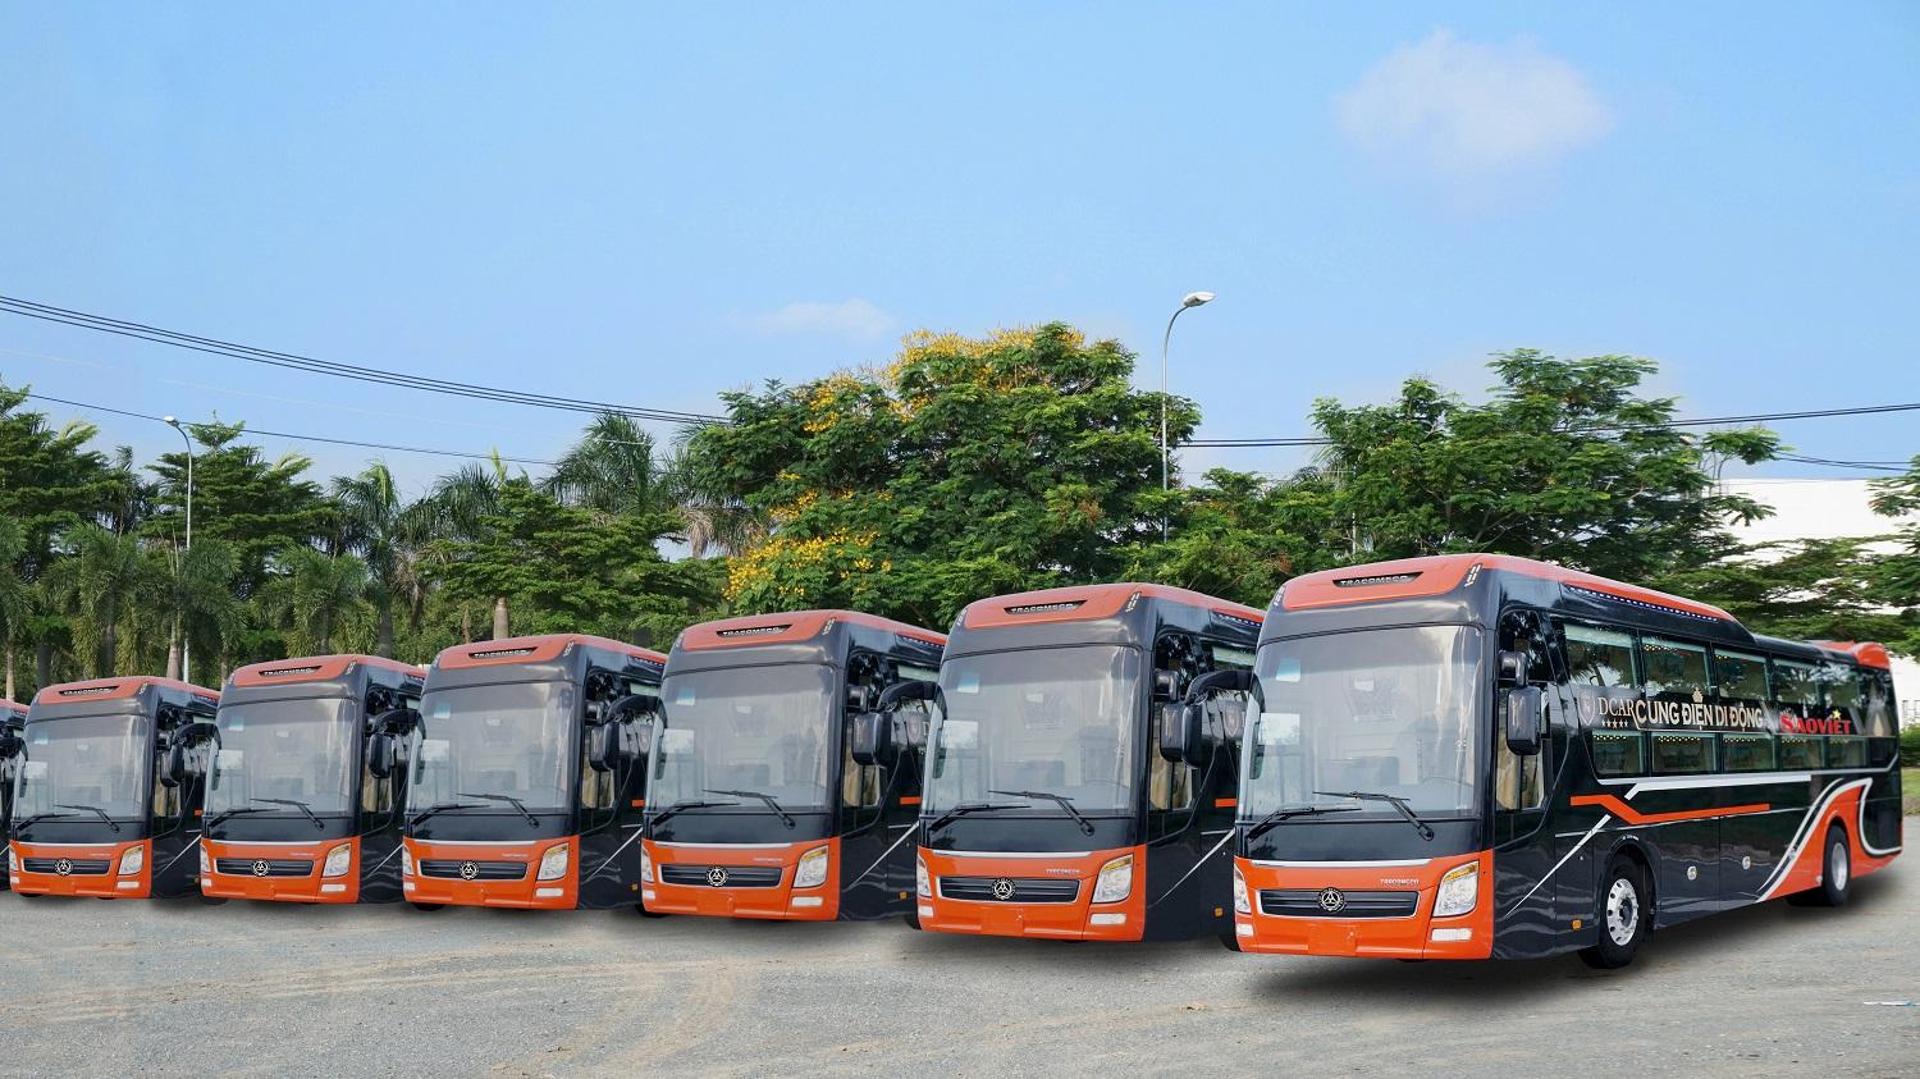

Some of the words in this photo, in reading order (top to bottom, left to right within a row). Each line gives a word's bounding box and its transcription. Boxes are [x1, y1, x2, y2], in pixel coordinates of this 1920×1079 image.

[1598, 697, 1636, 717] DCAR
[1635, 699, 1680, 724] CUNG
[1715, 704, 1729, 727] DI
